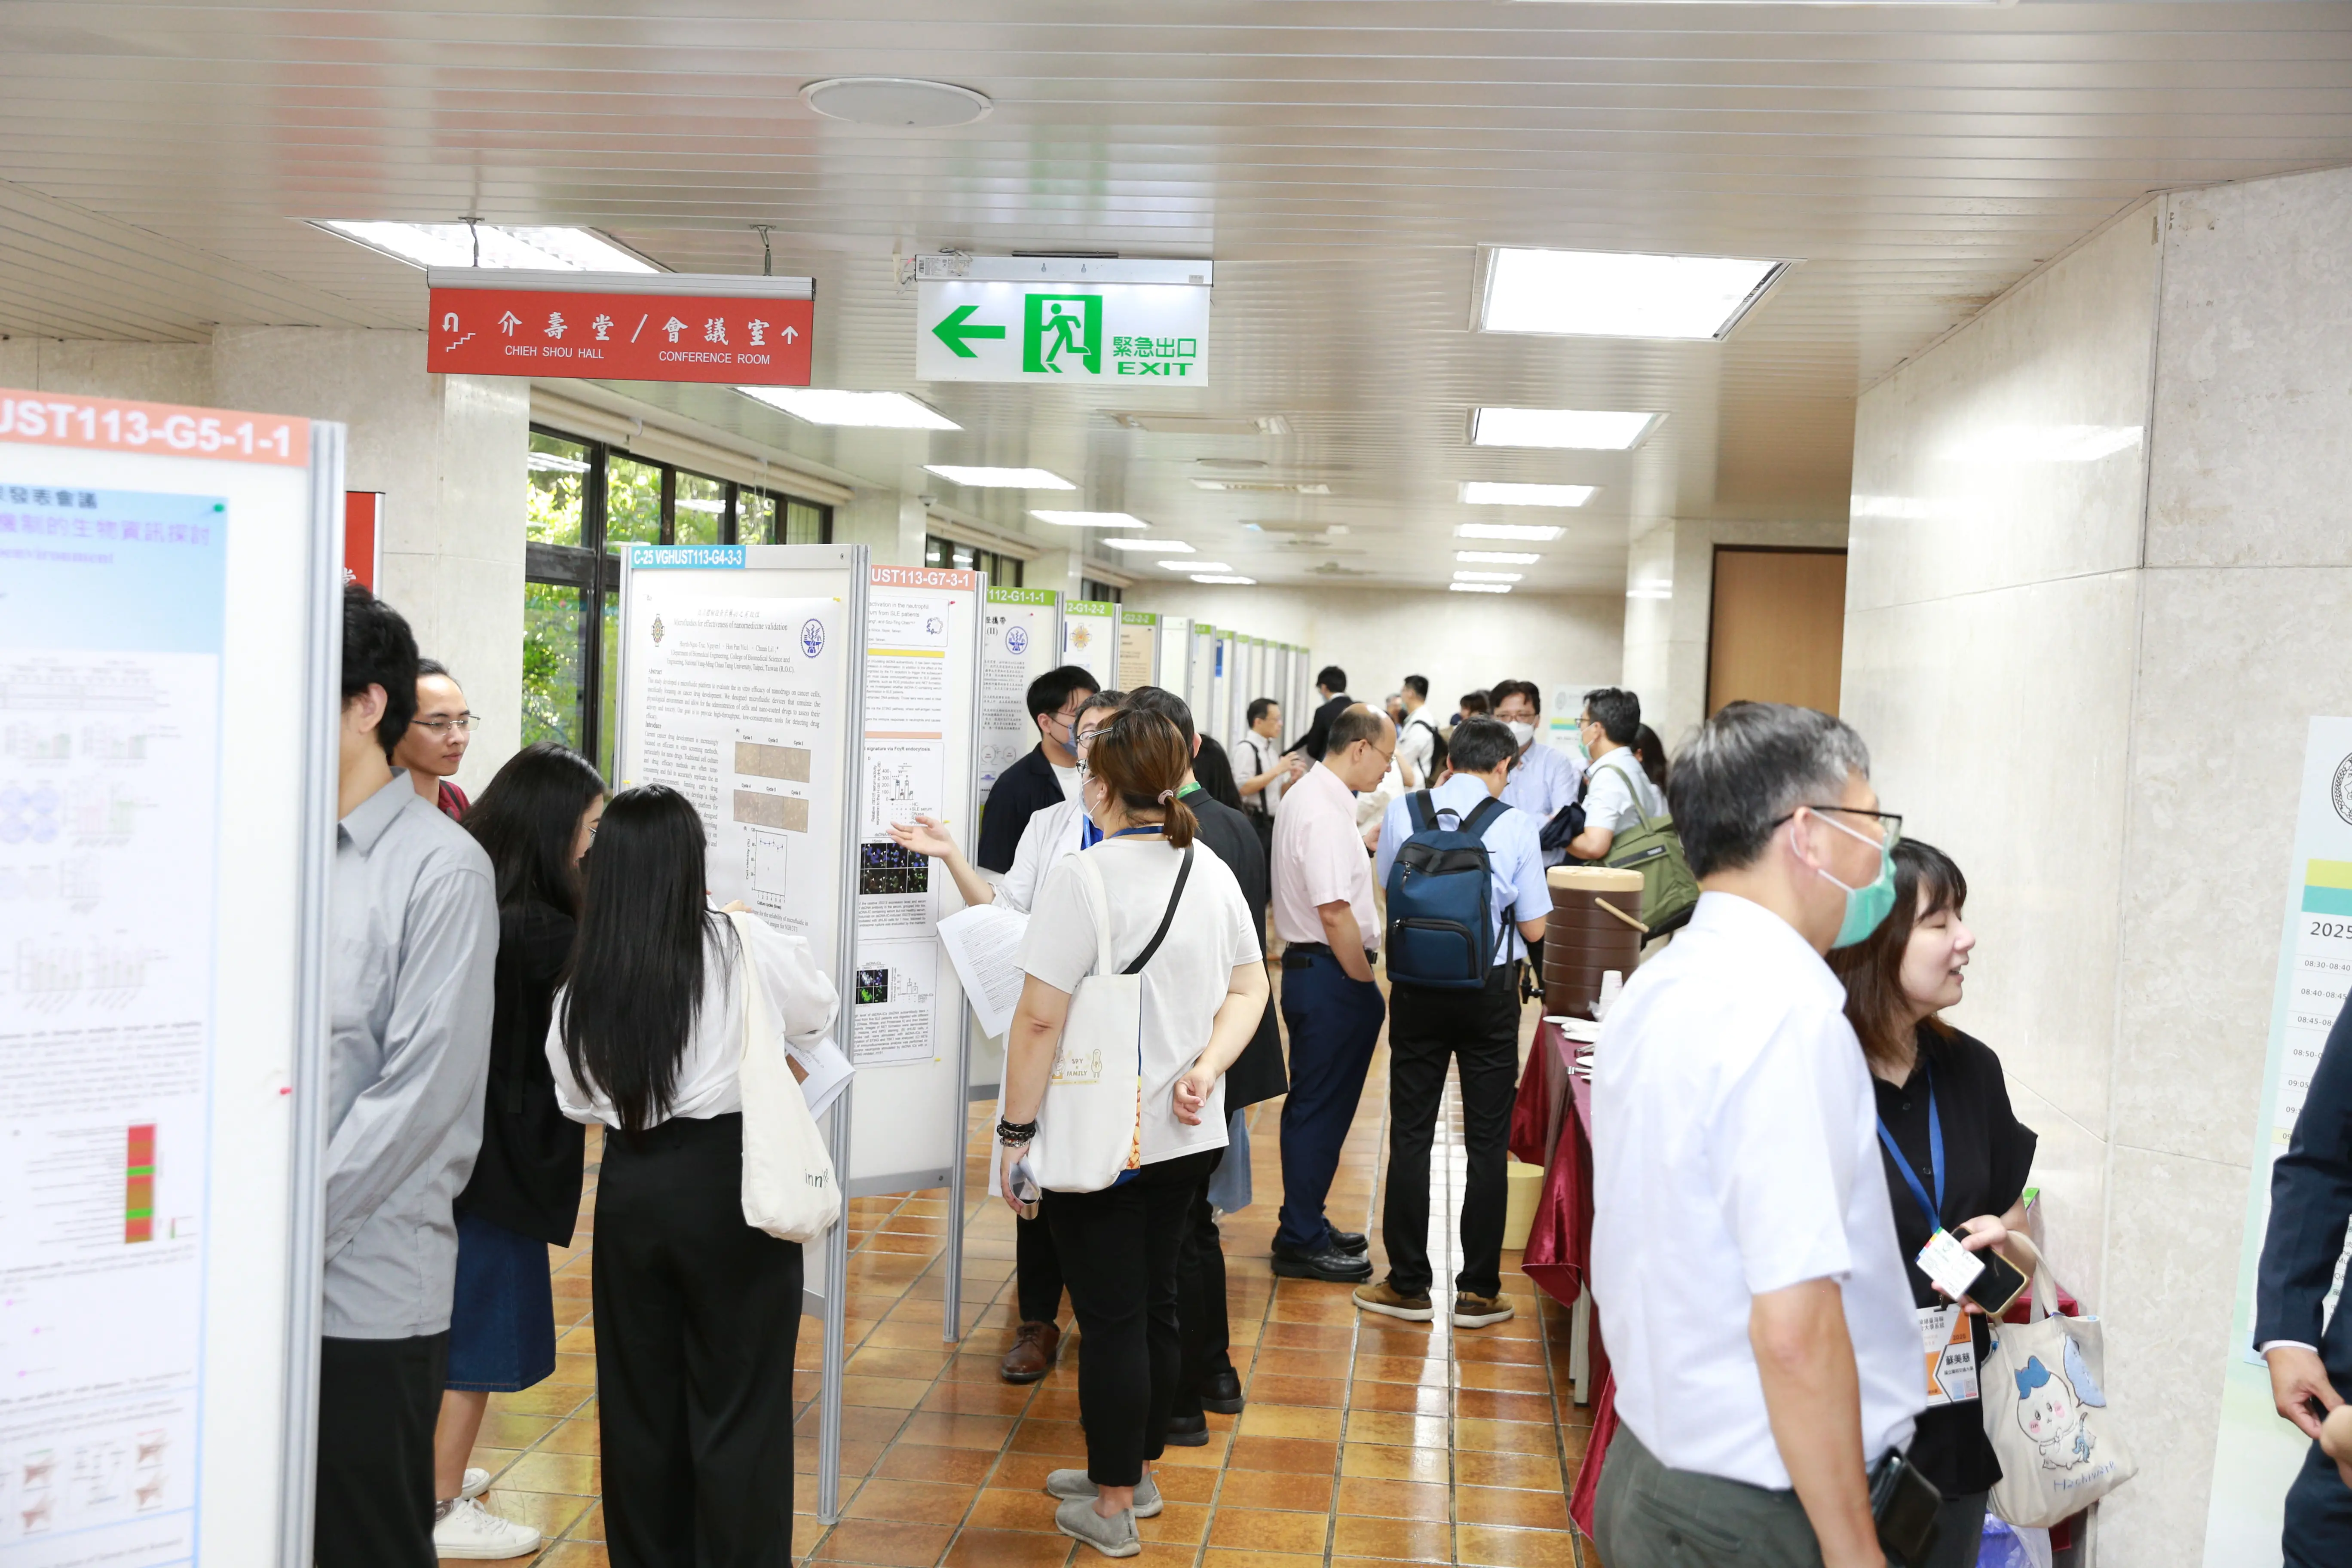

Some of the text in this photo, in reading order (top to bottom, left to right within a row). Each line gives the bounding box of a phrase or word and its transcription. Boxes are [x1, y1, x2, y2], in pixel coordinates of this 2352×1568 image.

[505, 346, 604, 359] CHIEH SHOU HALL
[1113, 336, 1197, 358] 緊急出口
[658, 350, 770, 365] CONFERENCE ROOM
[1118, 361, 1193, 376] EXIT
[634, 549, 742, 565] C-25 VGHUST113-G4-3-3
[871, 568, 969, 587] UST113-G7-3-1
[734, 622, 764, 630] nanomedicine
[765, 622, 787, 631] validation
[730, 653, 743, 661] College
[734, 663, 752, 671] University,
[751, 686, 765, 694] efficacy
[743, 713, 772, 723] low-consumption
[793, 718, 808, 727] detecting
[810, 720, 820, 729] drug
[769, 913, 782, 922] reliability
[2310, 922, 2352, 940] 2025
[2305, 960, 2350, 971] 08:30-08:40
[2301, 988, 2347, 999] 08:40-08:45
